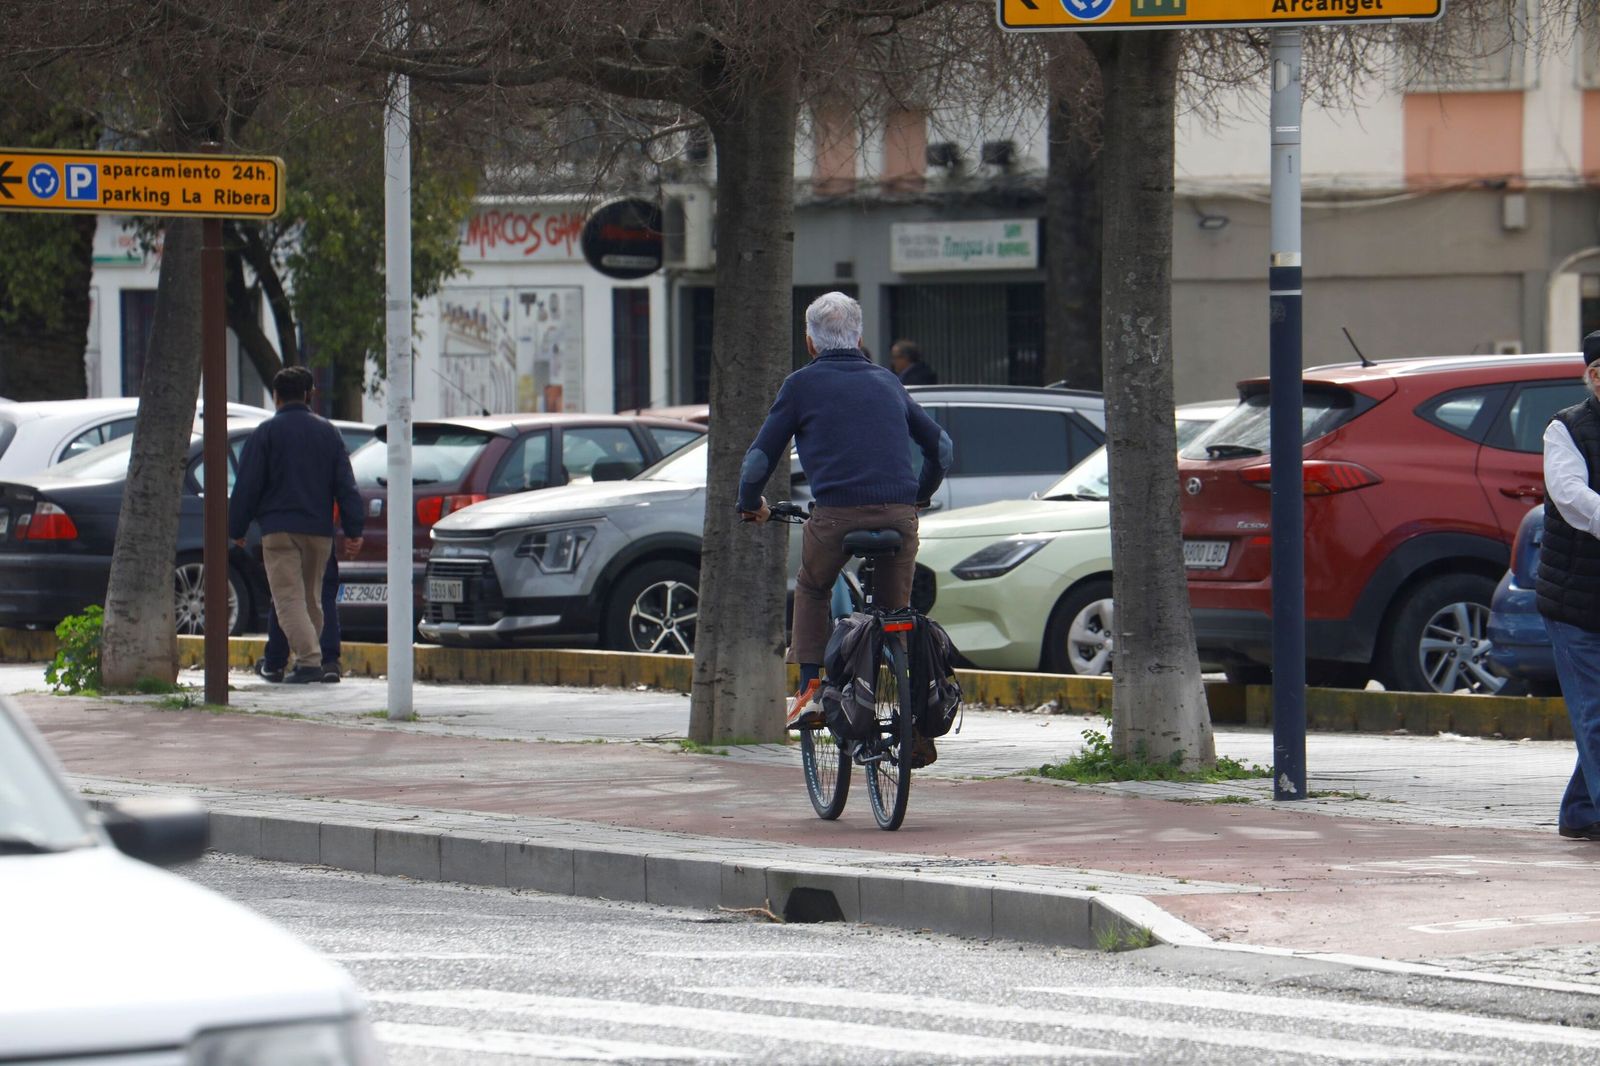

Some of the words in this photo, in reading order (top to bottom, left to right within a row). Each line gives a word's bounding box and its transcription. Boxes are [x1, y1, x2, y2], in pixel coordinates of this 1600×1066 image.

[70, 166, 92, 198] P
[102, 163, 221, 179] aparcamiento
[232, 165, 272, 181] 24h.
[102, 187, 170, 206] parking
[182, 188, 202, 204] La
[214, 189, 271, 206] Ribera
[468, 210, 541, 258] MARCOS
